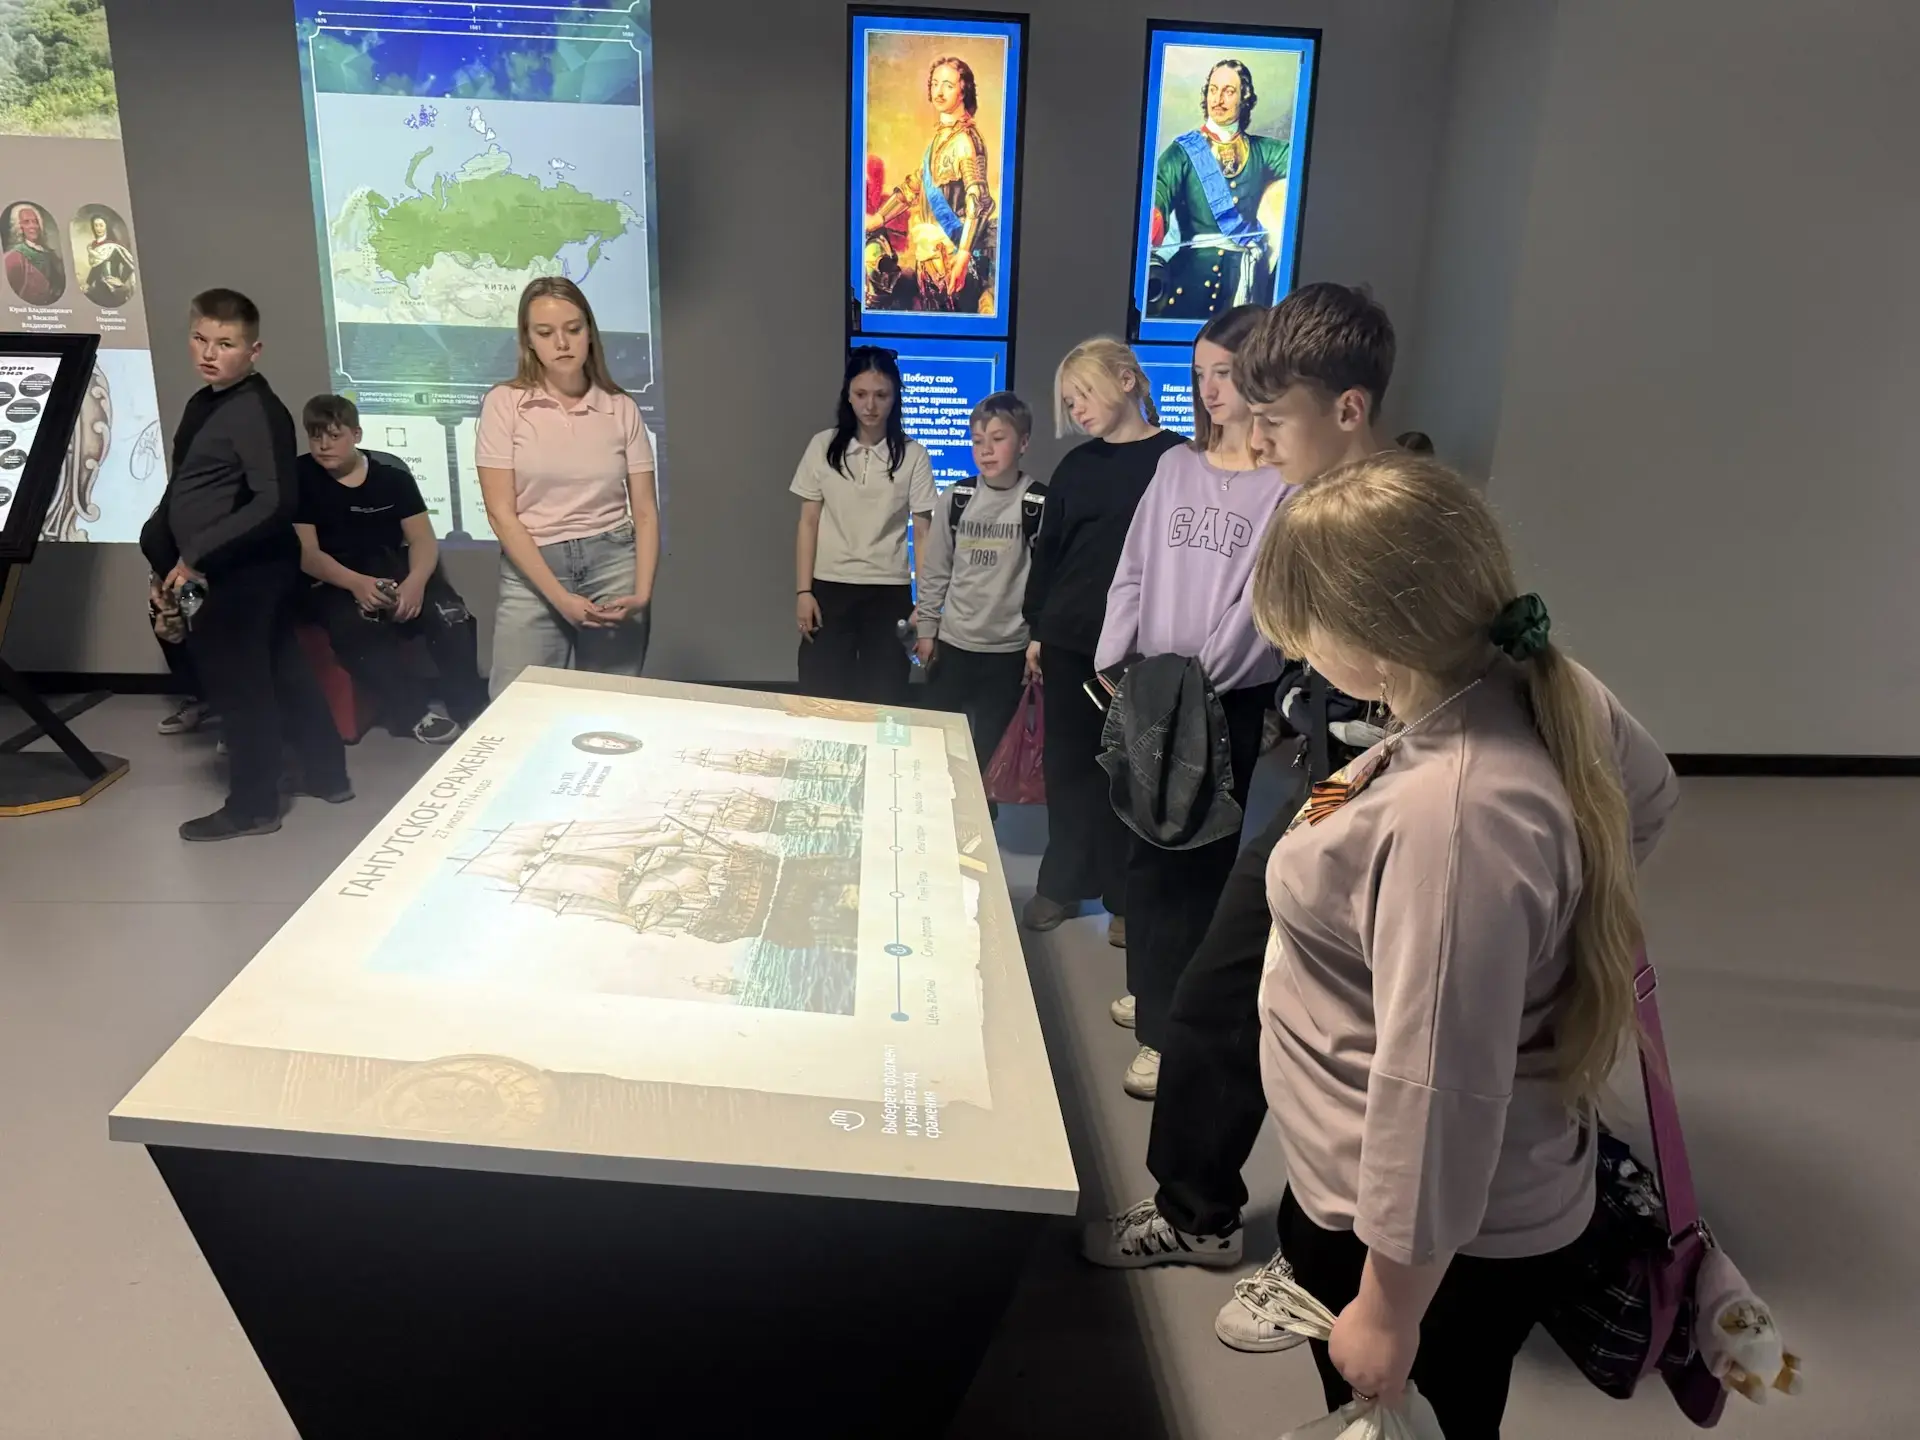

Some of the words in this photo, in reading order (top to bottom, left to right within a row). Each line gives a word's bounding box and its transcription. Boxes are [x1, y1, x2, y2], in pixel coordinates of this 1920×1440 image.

[484, 283, 517, 291] КИТАЙ
[903, 373, 934, 384] Победу
[935, 375, 954, 383] сию
[905, 385, 958, 395] превеликою
[1162, 383, 1186, 393] Наша
[930, 397, 968, 406] приняли
[918, 405, 939, 414] Бога
[935, 416, 951, 425] ибо
[949, 427, 966, 438] Ему
[917, 438, 973, 447] приписывать
[947, 468, 970, 478] Бога,
[958, 520, 1021, 539] ARAMOUNT
[1167, 507, 1253, 558] GAP
[338, 800, 447, 898] ГАНГУТСКОЕ
[429, 735, 505, 799] СРАЖЕНИЕ
[884, 1043, 900, 1087] фрагмент
[903, 1071, 921, 1088] ход
[899, 1088, 922, 1129] узнайте
[923, 1090, 943, 1139] сражения
[905, 1129, 919, 1137] и
